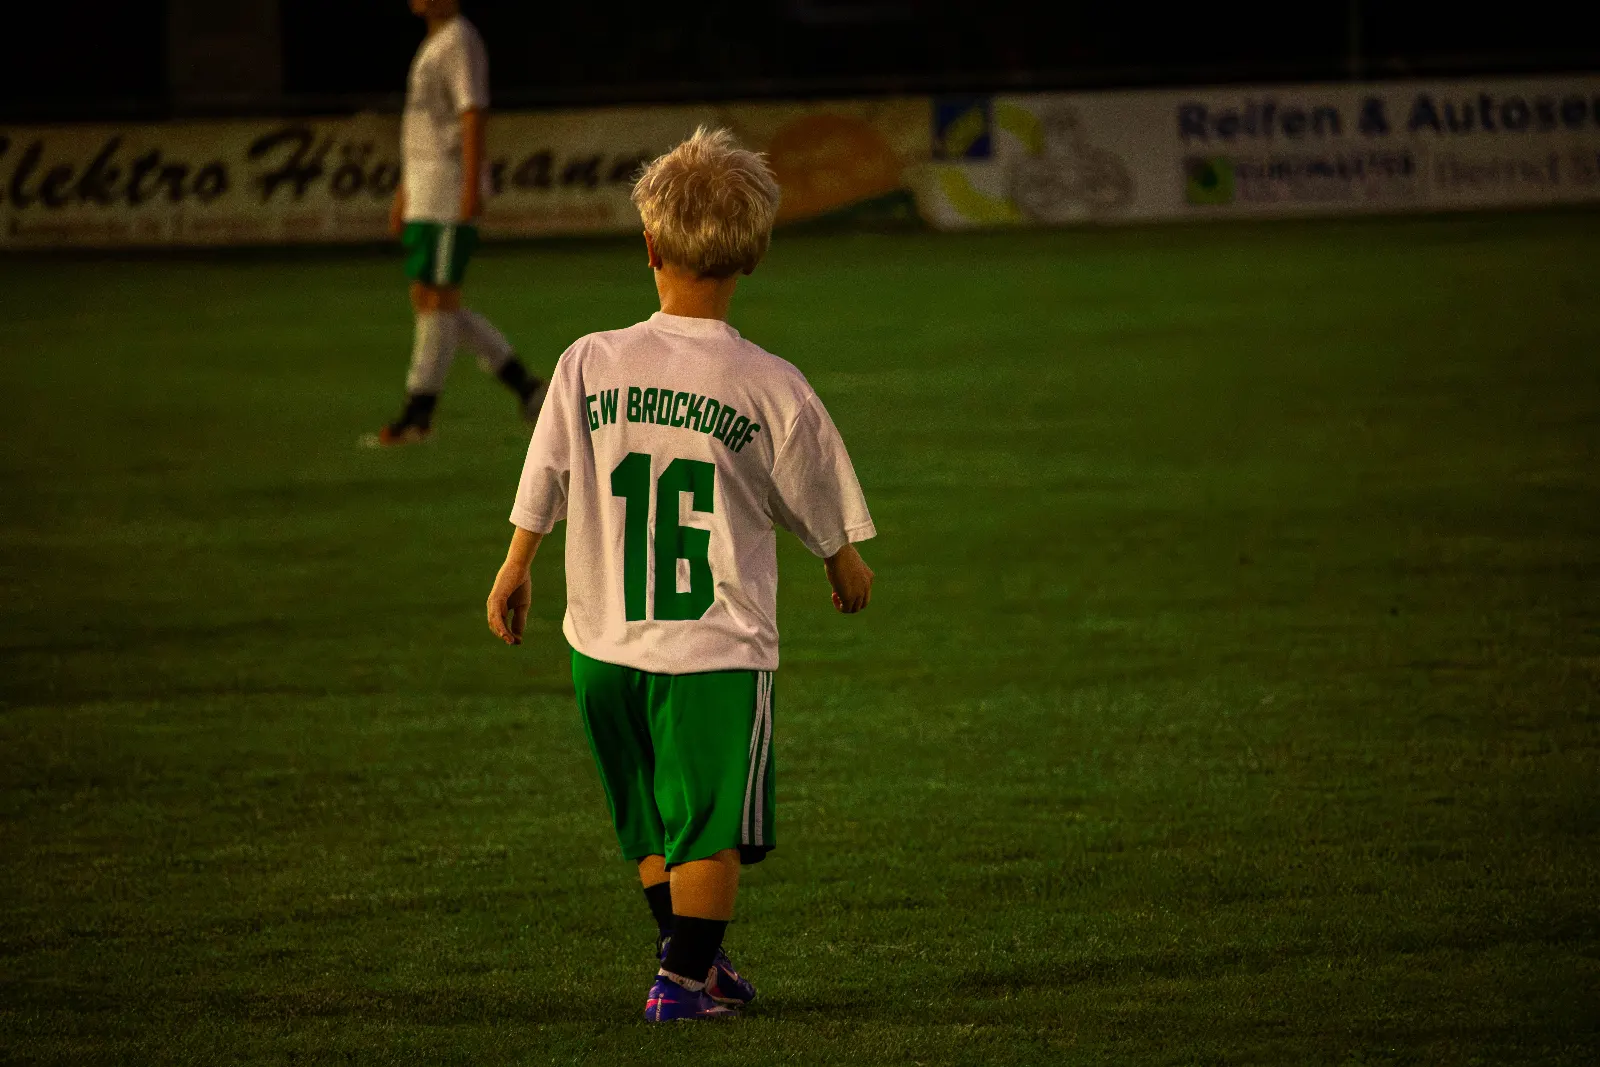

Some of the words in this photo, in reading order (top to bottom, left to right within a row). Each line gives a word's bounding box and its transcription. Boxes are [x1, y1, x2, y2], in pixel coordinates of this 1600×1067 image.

[1178, 98, 1343, 140] Reifen
[1357, 96, 1391, 137] &
[0, 133, 229, 209] lektro
[586, 387, 619, 432] GW
[627, 386, 761, 453] BROCKDORF
[611, 451, 716, 622] 16
